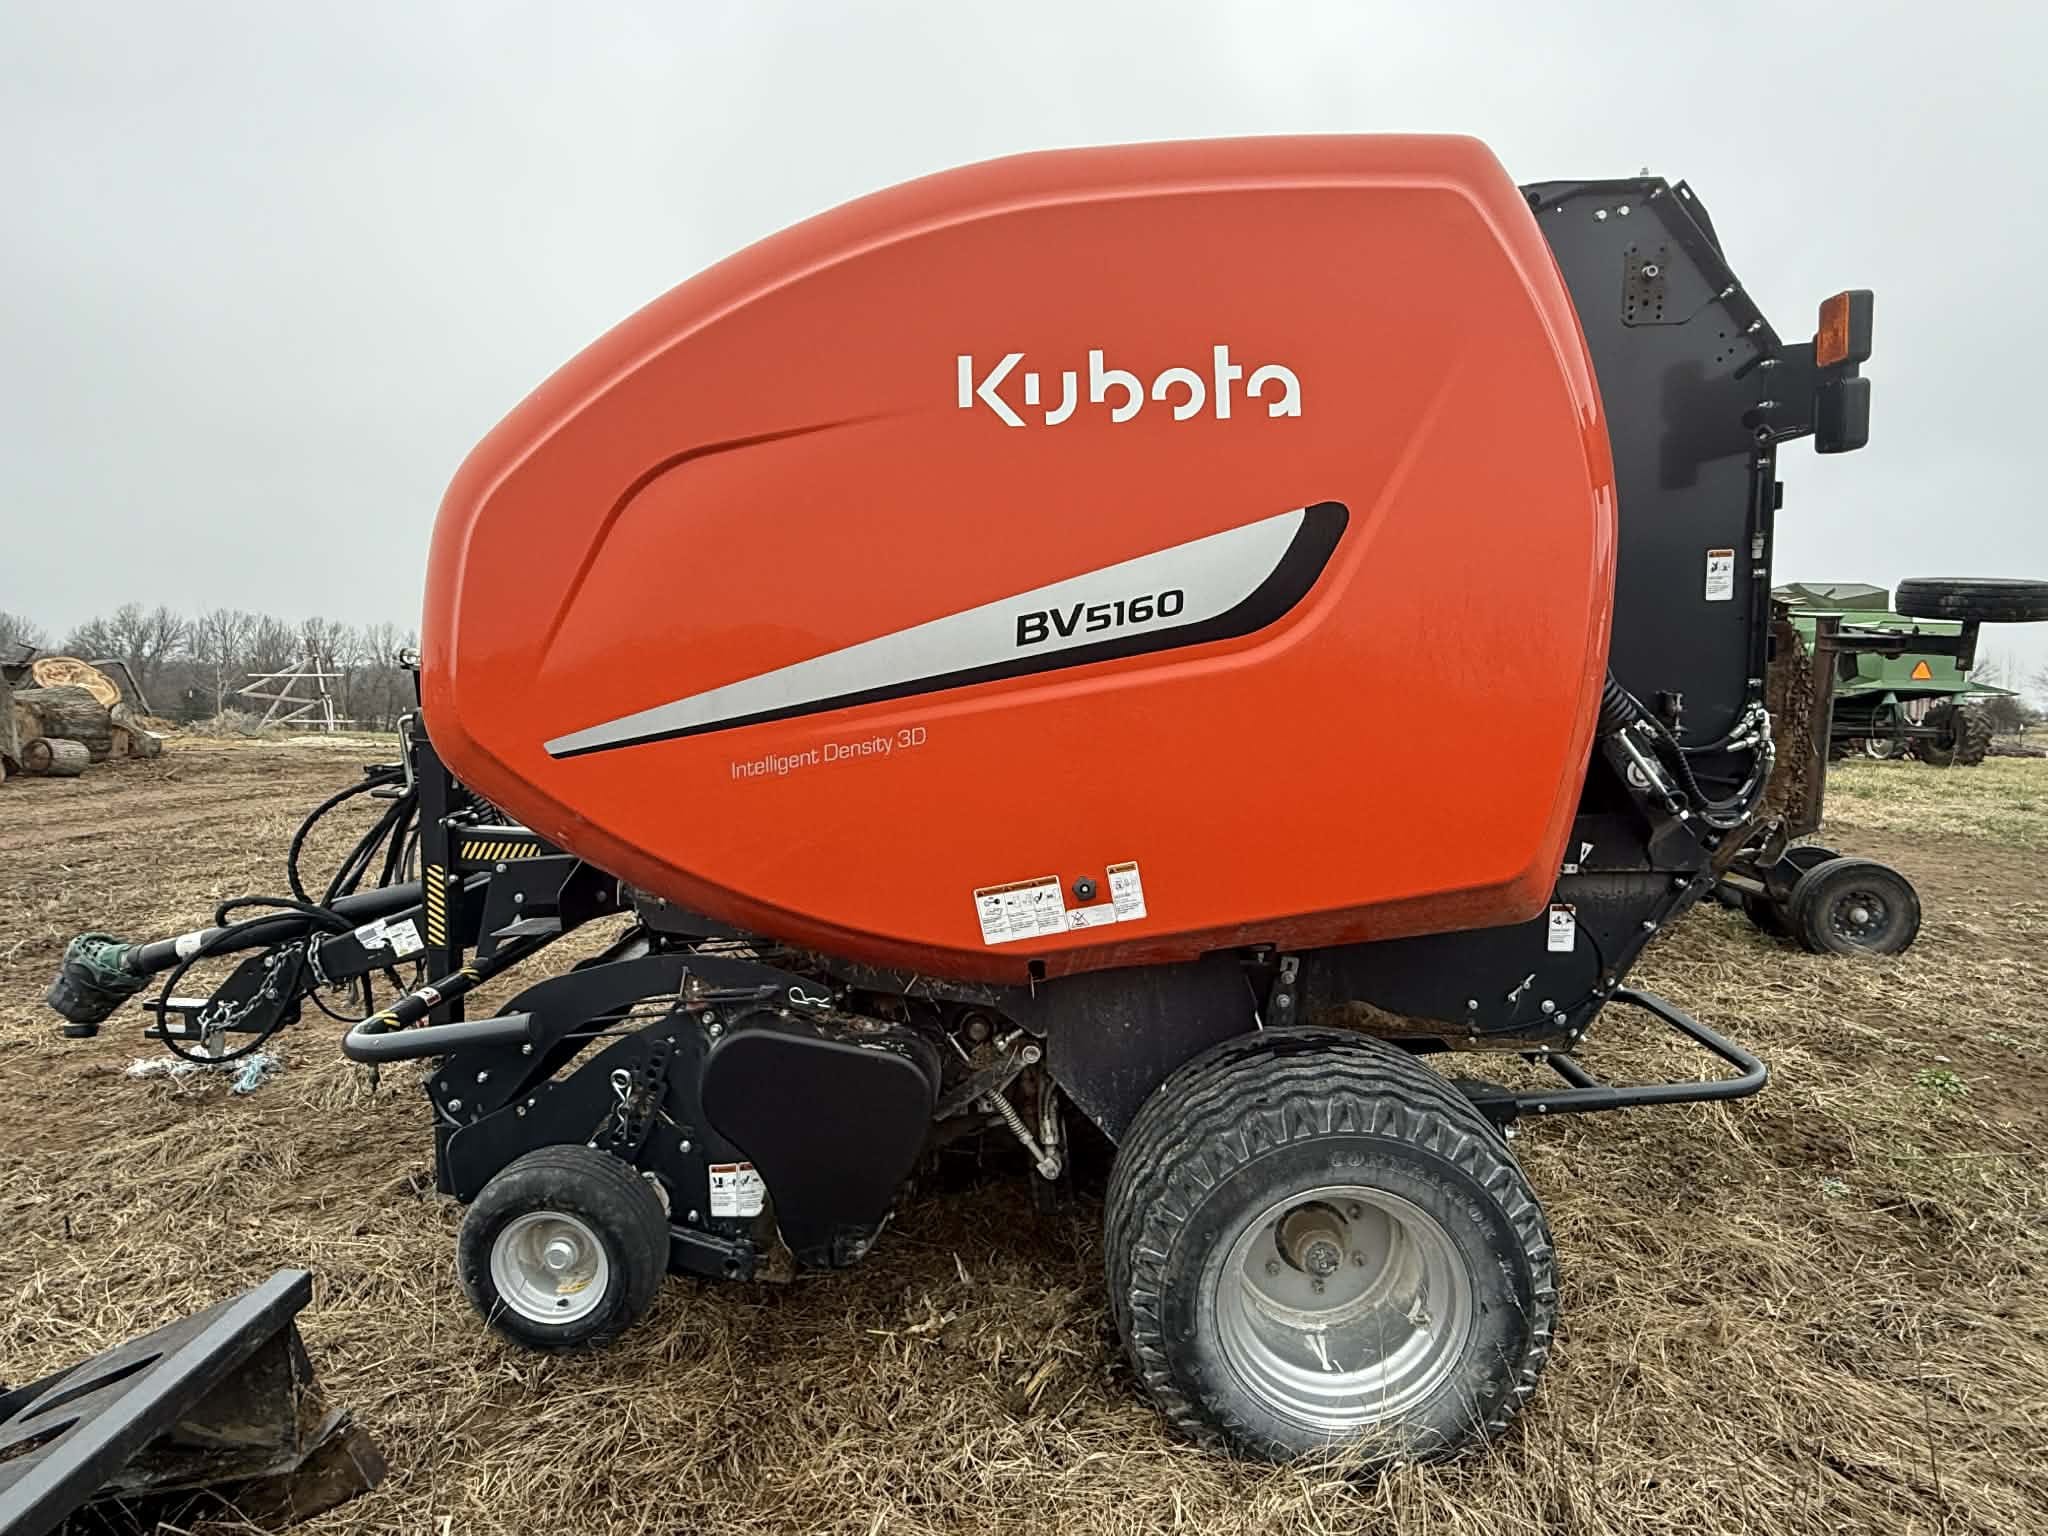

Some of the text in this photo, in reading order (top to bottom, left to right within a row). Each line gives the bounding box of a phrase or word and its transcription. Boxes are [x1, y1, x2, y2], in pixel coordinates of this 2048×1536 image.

[957, 345, 1302, 427] Kubota
[1016, 590, 1184, 647] BV5160
[731, 727, 927, 779] Intelligent Density 3D
